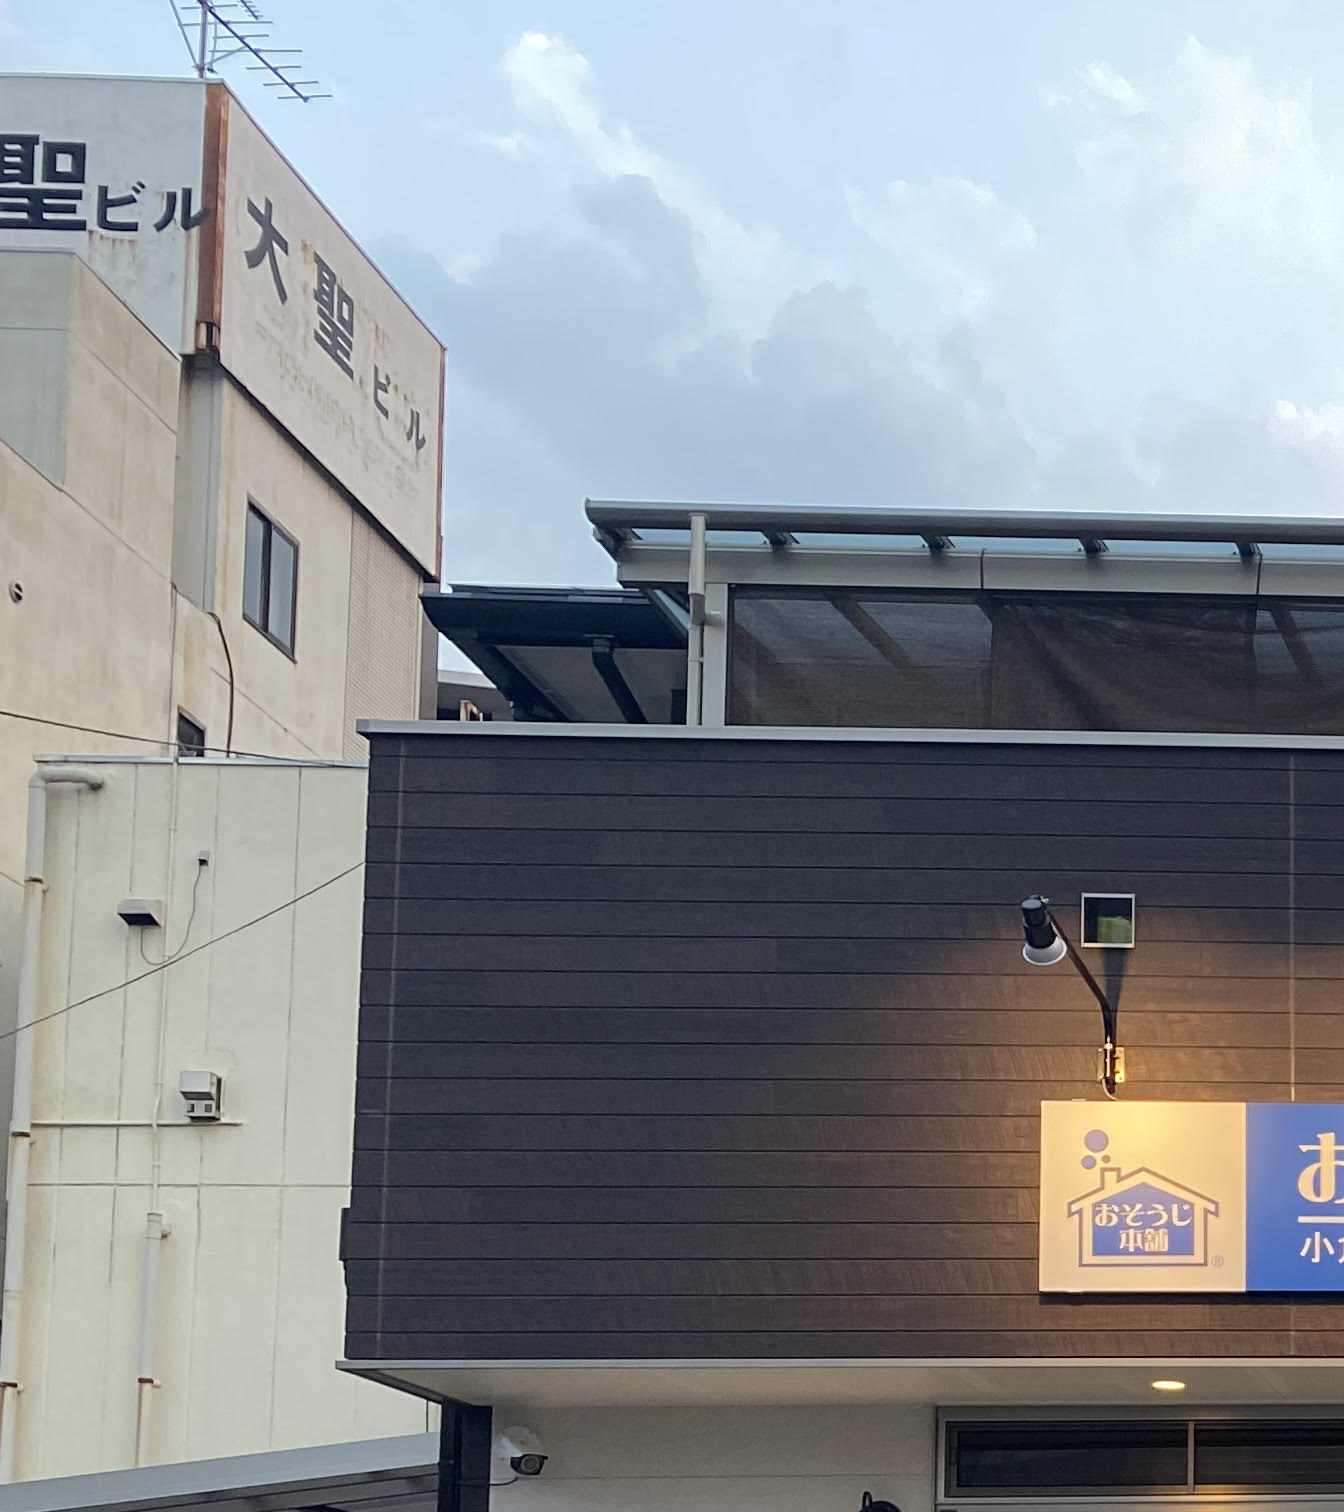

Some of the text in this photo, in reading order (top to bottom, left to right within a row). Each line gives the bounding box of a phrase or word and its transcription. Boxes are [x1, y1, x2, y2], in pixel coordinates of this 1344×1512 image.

[1094, 1203, 1192, 1227] おそうじ
[1119, 1228, 1169, 1253] 本舗
